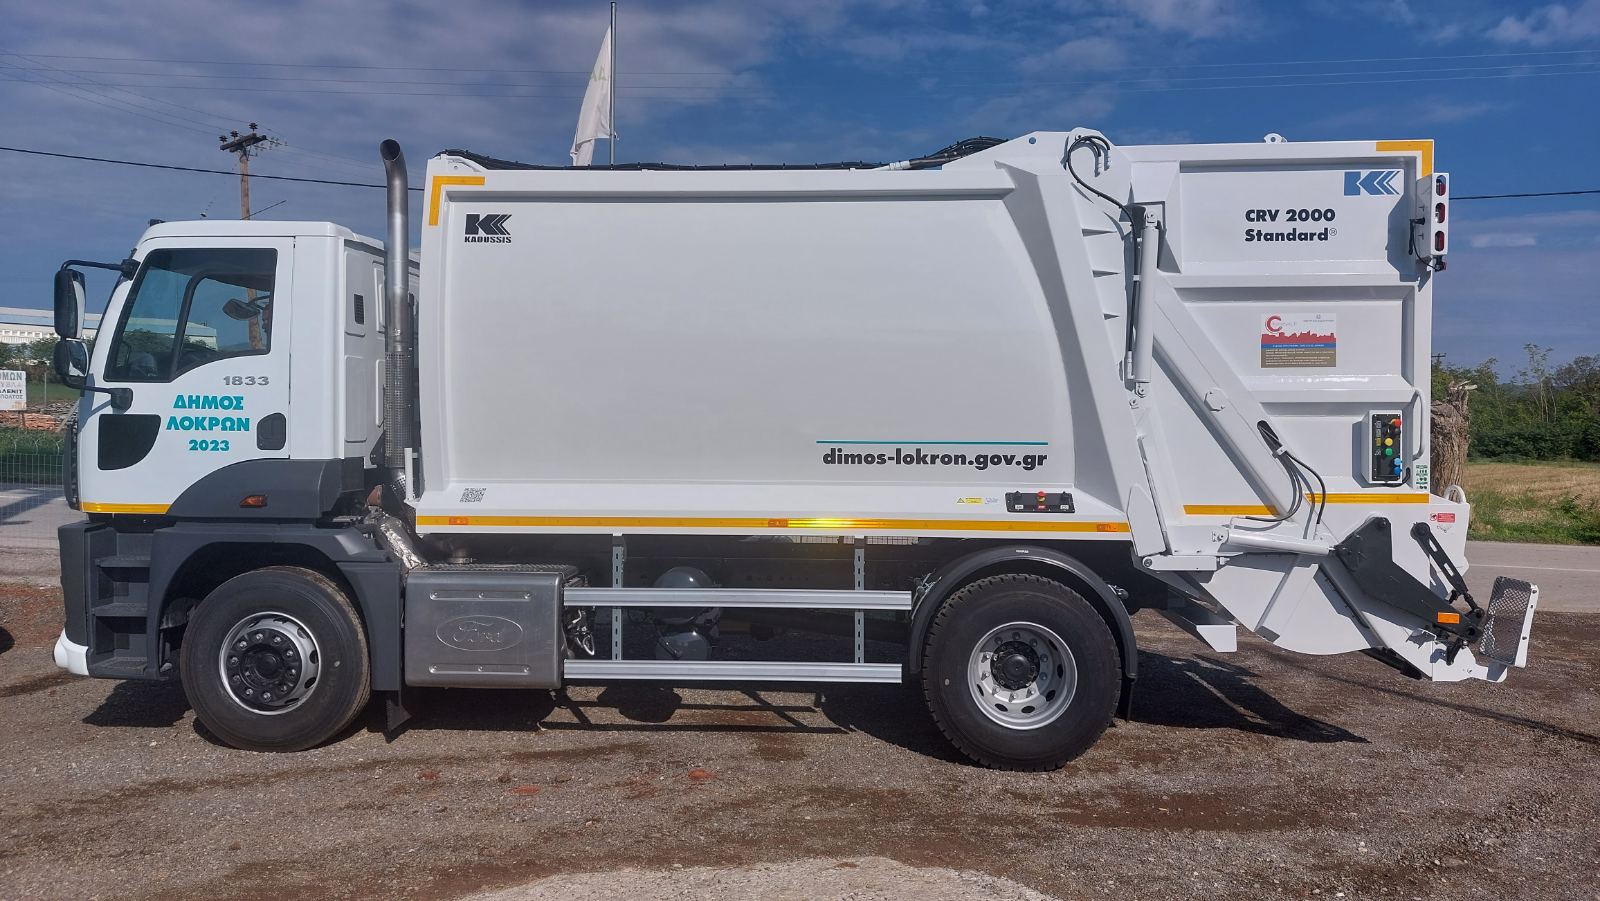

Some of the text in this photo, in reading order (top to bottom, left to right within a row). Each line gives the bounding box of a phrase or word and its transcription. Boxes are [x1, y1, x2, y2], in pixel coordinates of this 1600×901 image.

[1245, 208, 1336, 223] CRV 2000
[0, 371, 23, 381] ΜΩΝ
[222, 375, 270, 386] 1833
[172, 394, 244, 410] ΔΗΜΟΣ
[166, 416, 250, 432] ΛΟΚΡΩΝ
[188, 439, 230, 452] 2023
[822, 448, 1048, 471] dimos-lokron.gov.gr
